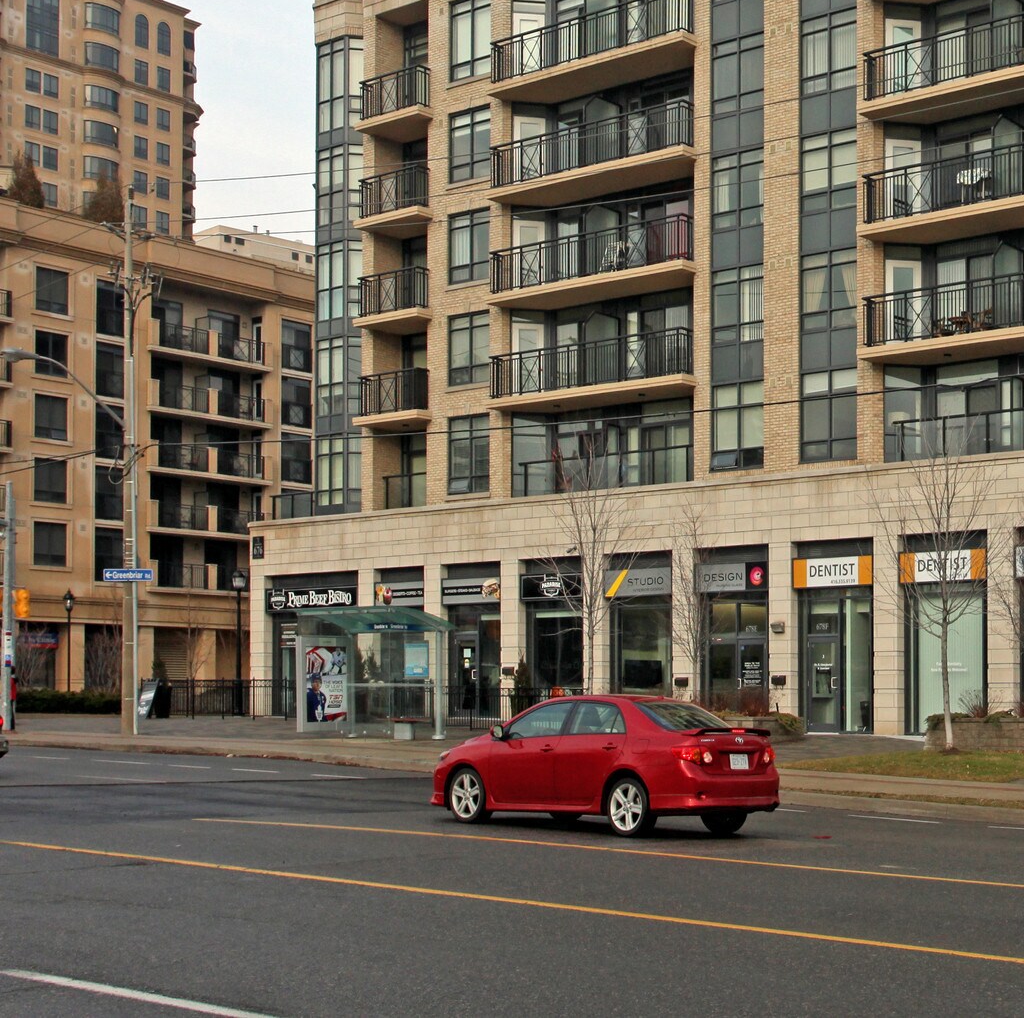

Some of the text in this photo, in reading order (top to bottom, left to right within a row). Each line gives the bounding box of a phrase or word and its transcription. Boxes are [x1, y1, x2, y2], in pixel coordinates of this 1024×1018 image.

[112, 571, 144, 579] Greenbriar
[809, 562, 856, 578] DENTIST
[627, 576, 664, 586] STUDIO
[703, 572, 743, 582] DESIGN
[286, 589, 353, 608] PRIME BEEF BISTRO
